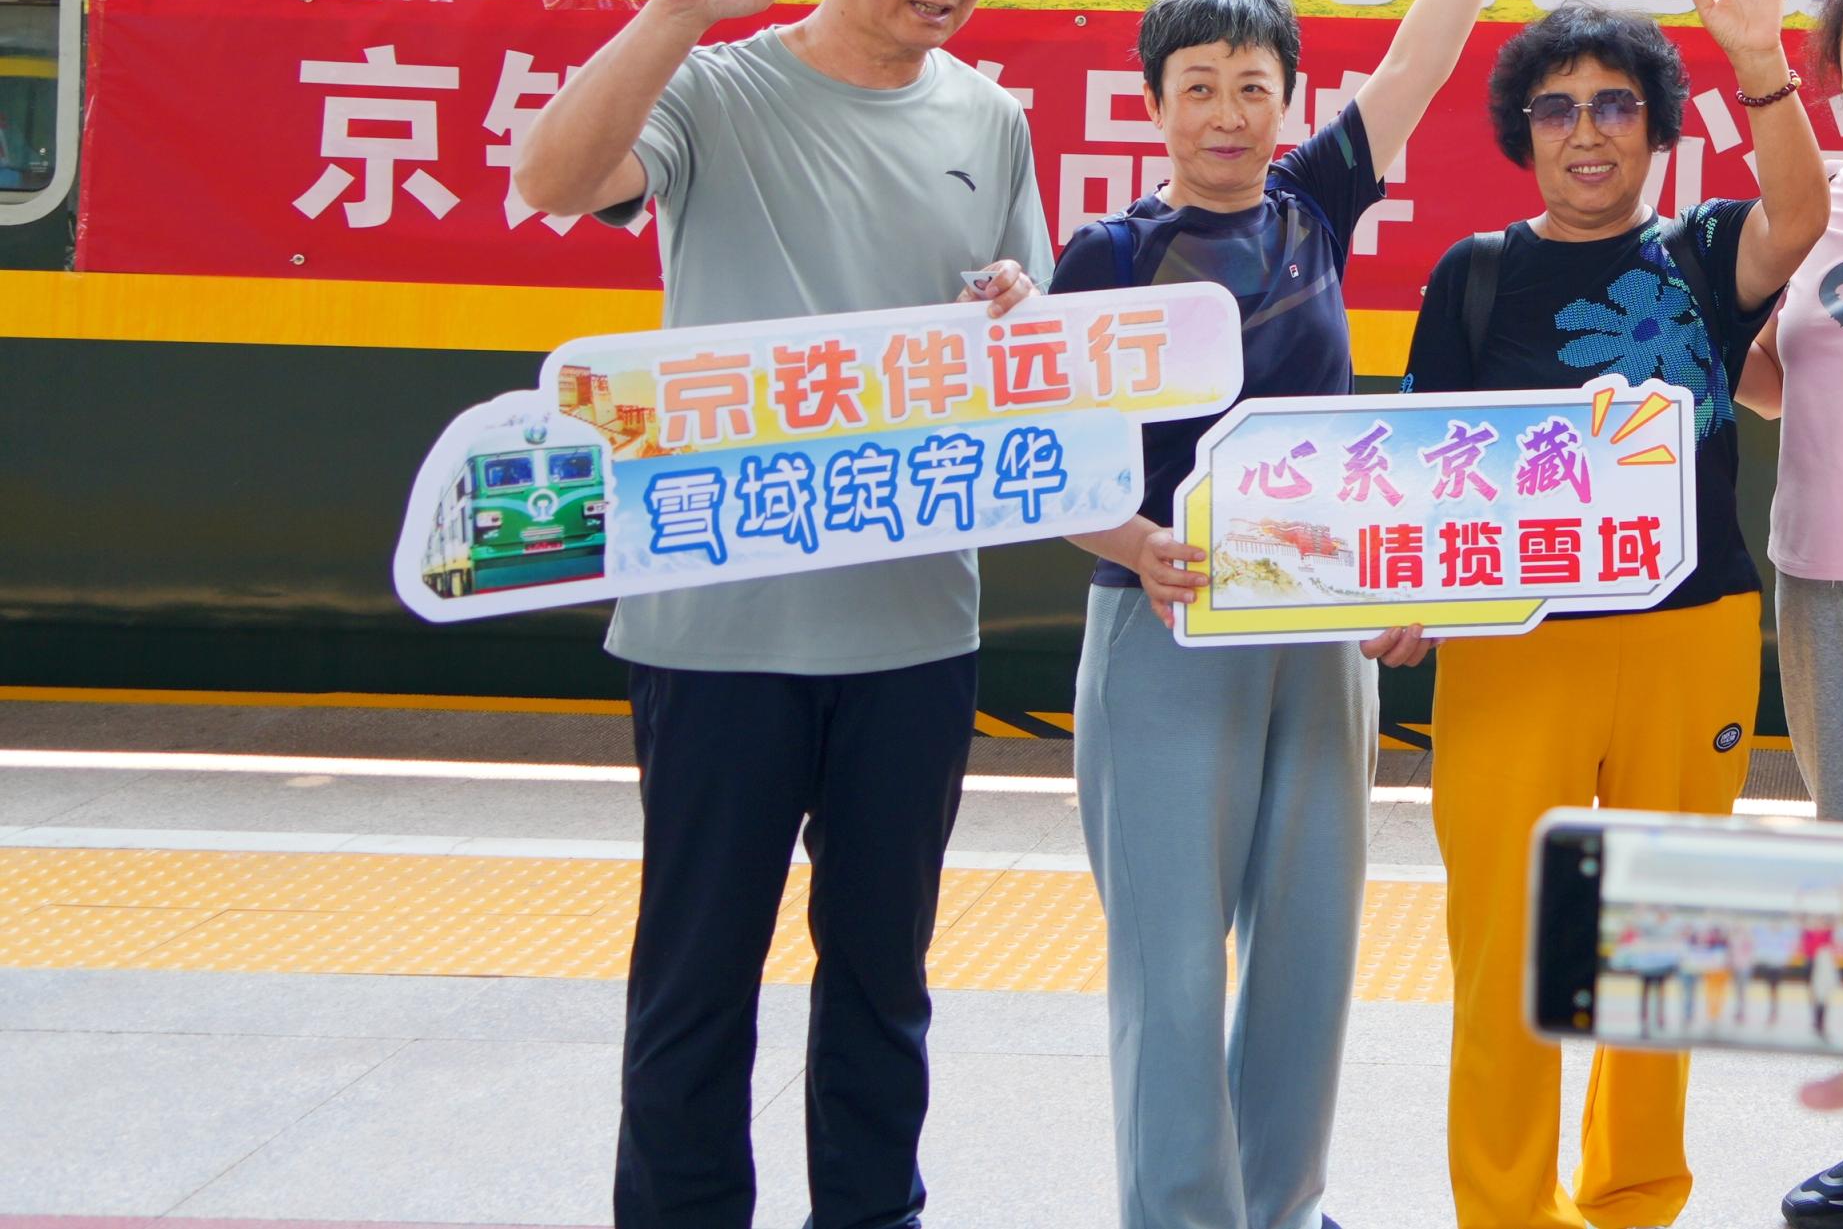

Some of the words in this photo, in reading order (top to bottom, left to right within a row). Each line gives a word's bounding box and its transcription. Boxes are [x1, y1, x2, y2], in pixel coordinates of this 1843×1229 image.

[657, 309, 1167, 445] 京铁伴远行
[644, 427, 1067, 566] 雪域绽芳华
[1236, 420, 1594, 506] 心系京藏
[1358, 515, 1663, 590] 情揽雪域
